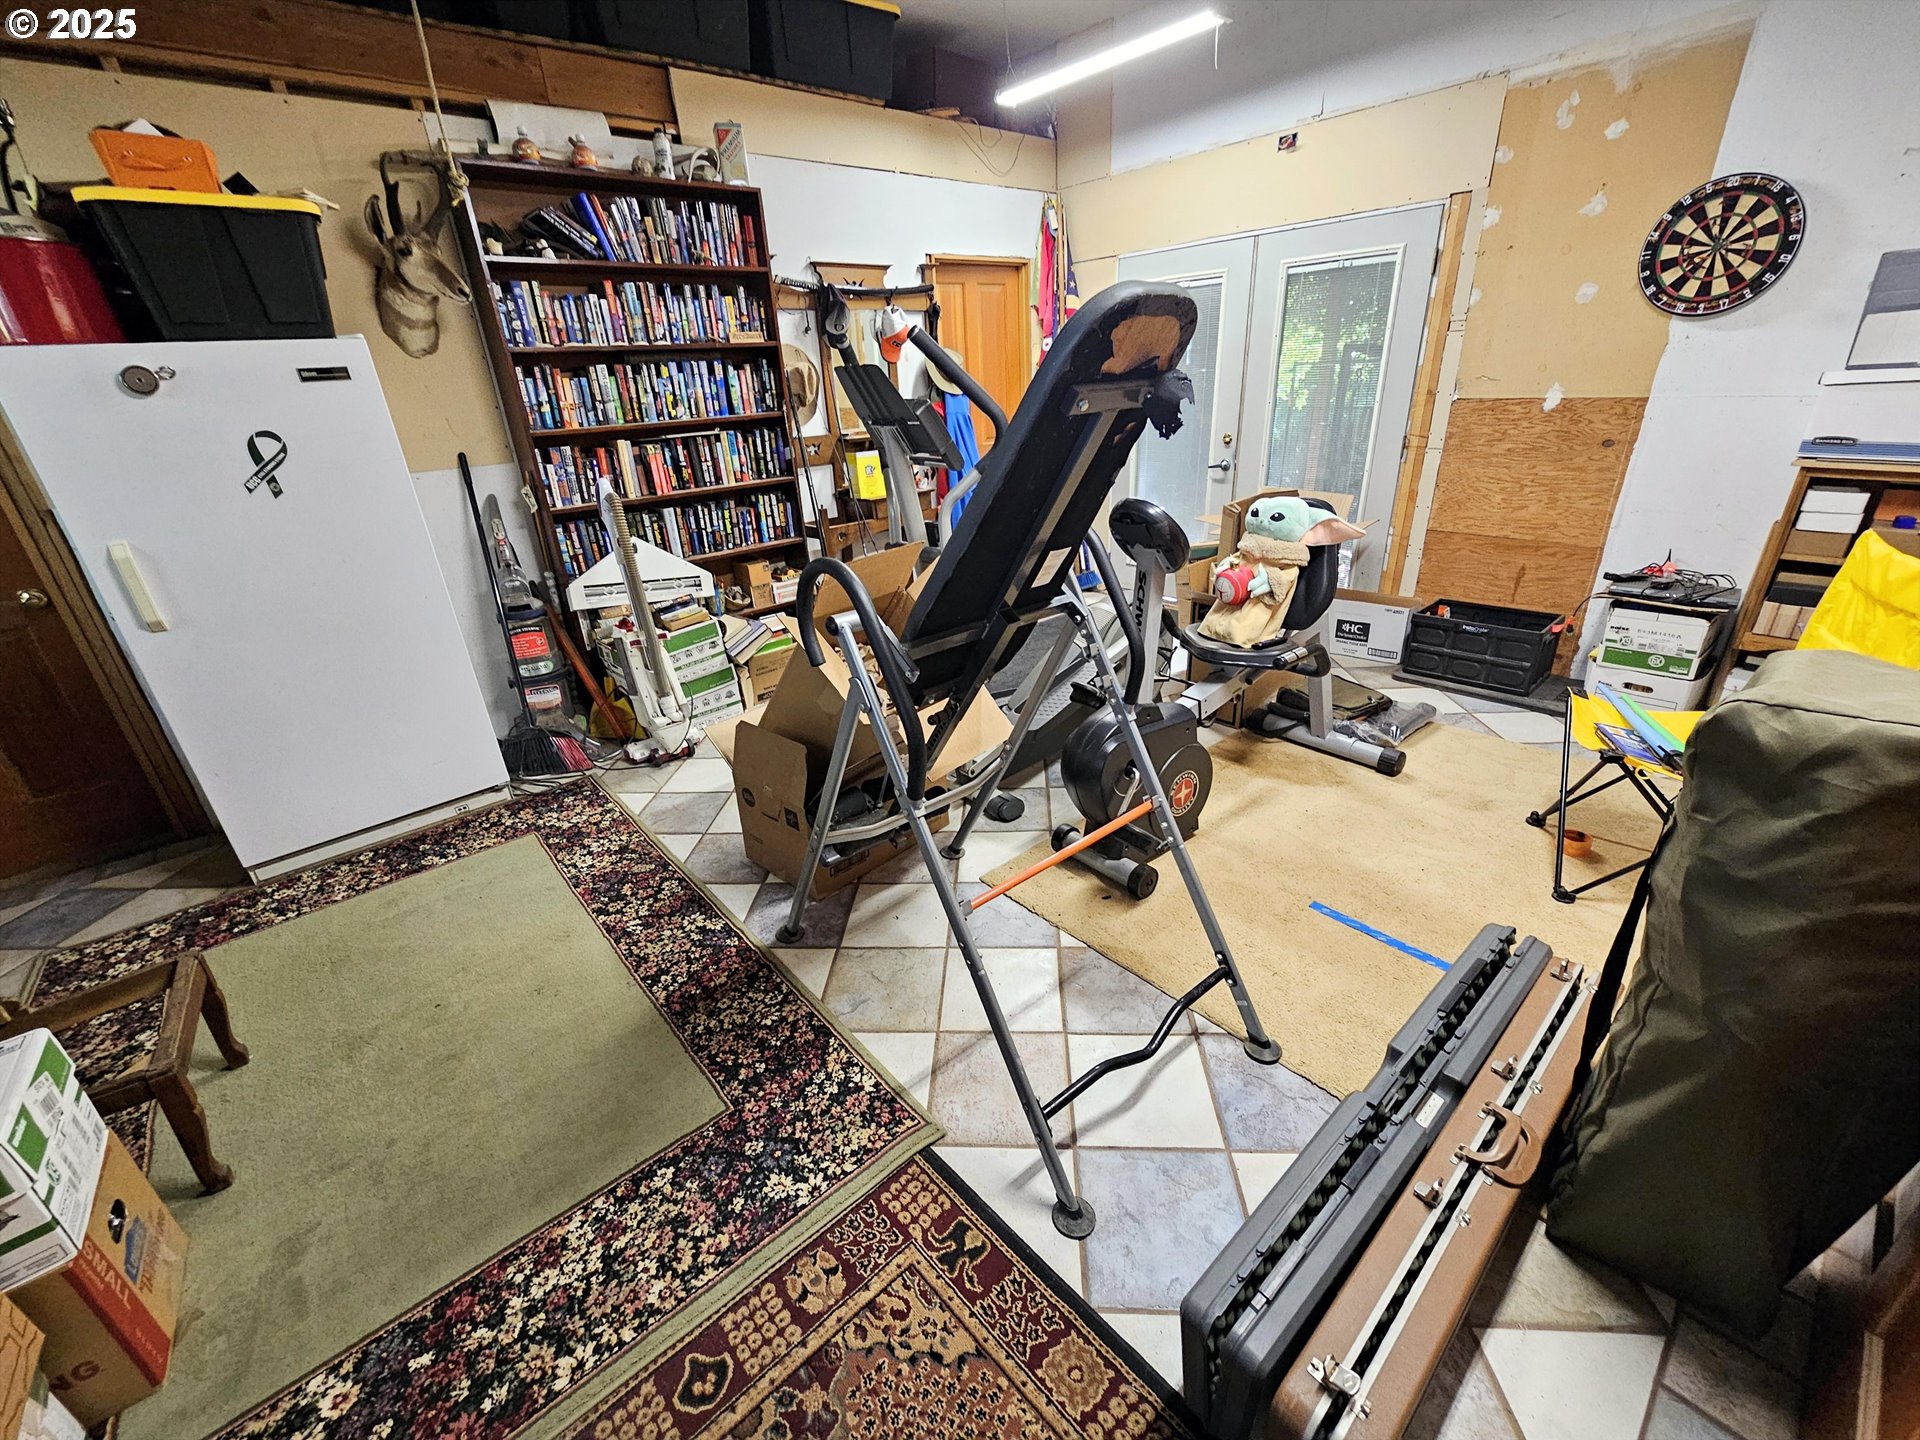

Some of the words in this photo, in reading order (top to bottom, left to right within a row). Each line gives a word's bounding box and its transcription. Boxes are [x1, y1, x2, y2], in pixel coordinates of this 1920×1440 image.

[720, 129, 741, 157] PREMIUM
[1727, 176, 1740, 187] 20
[1754, 175, 1761, 186] 1
[1706, 183, 1713, 193] 5
[1680, 195, 1693, 206] 12
[1785, 191, 1798, 204] 4
[1663, 213, 1673, 221] 9
[1641, 251, 1652, 260] 11
[1778, 253, 1793, 263] 10
[1640, 270, 1650, 278] 8
[1762, 272, 1776, 284] 15
[1743, 288, 1753, 299] 2
[1658, 296, 1668, 306] 7
[1720, 299, 1729, 309] 17
[1697, 304, 1705, 313] 3
[83, 1240, 131, 1310] SMALL
